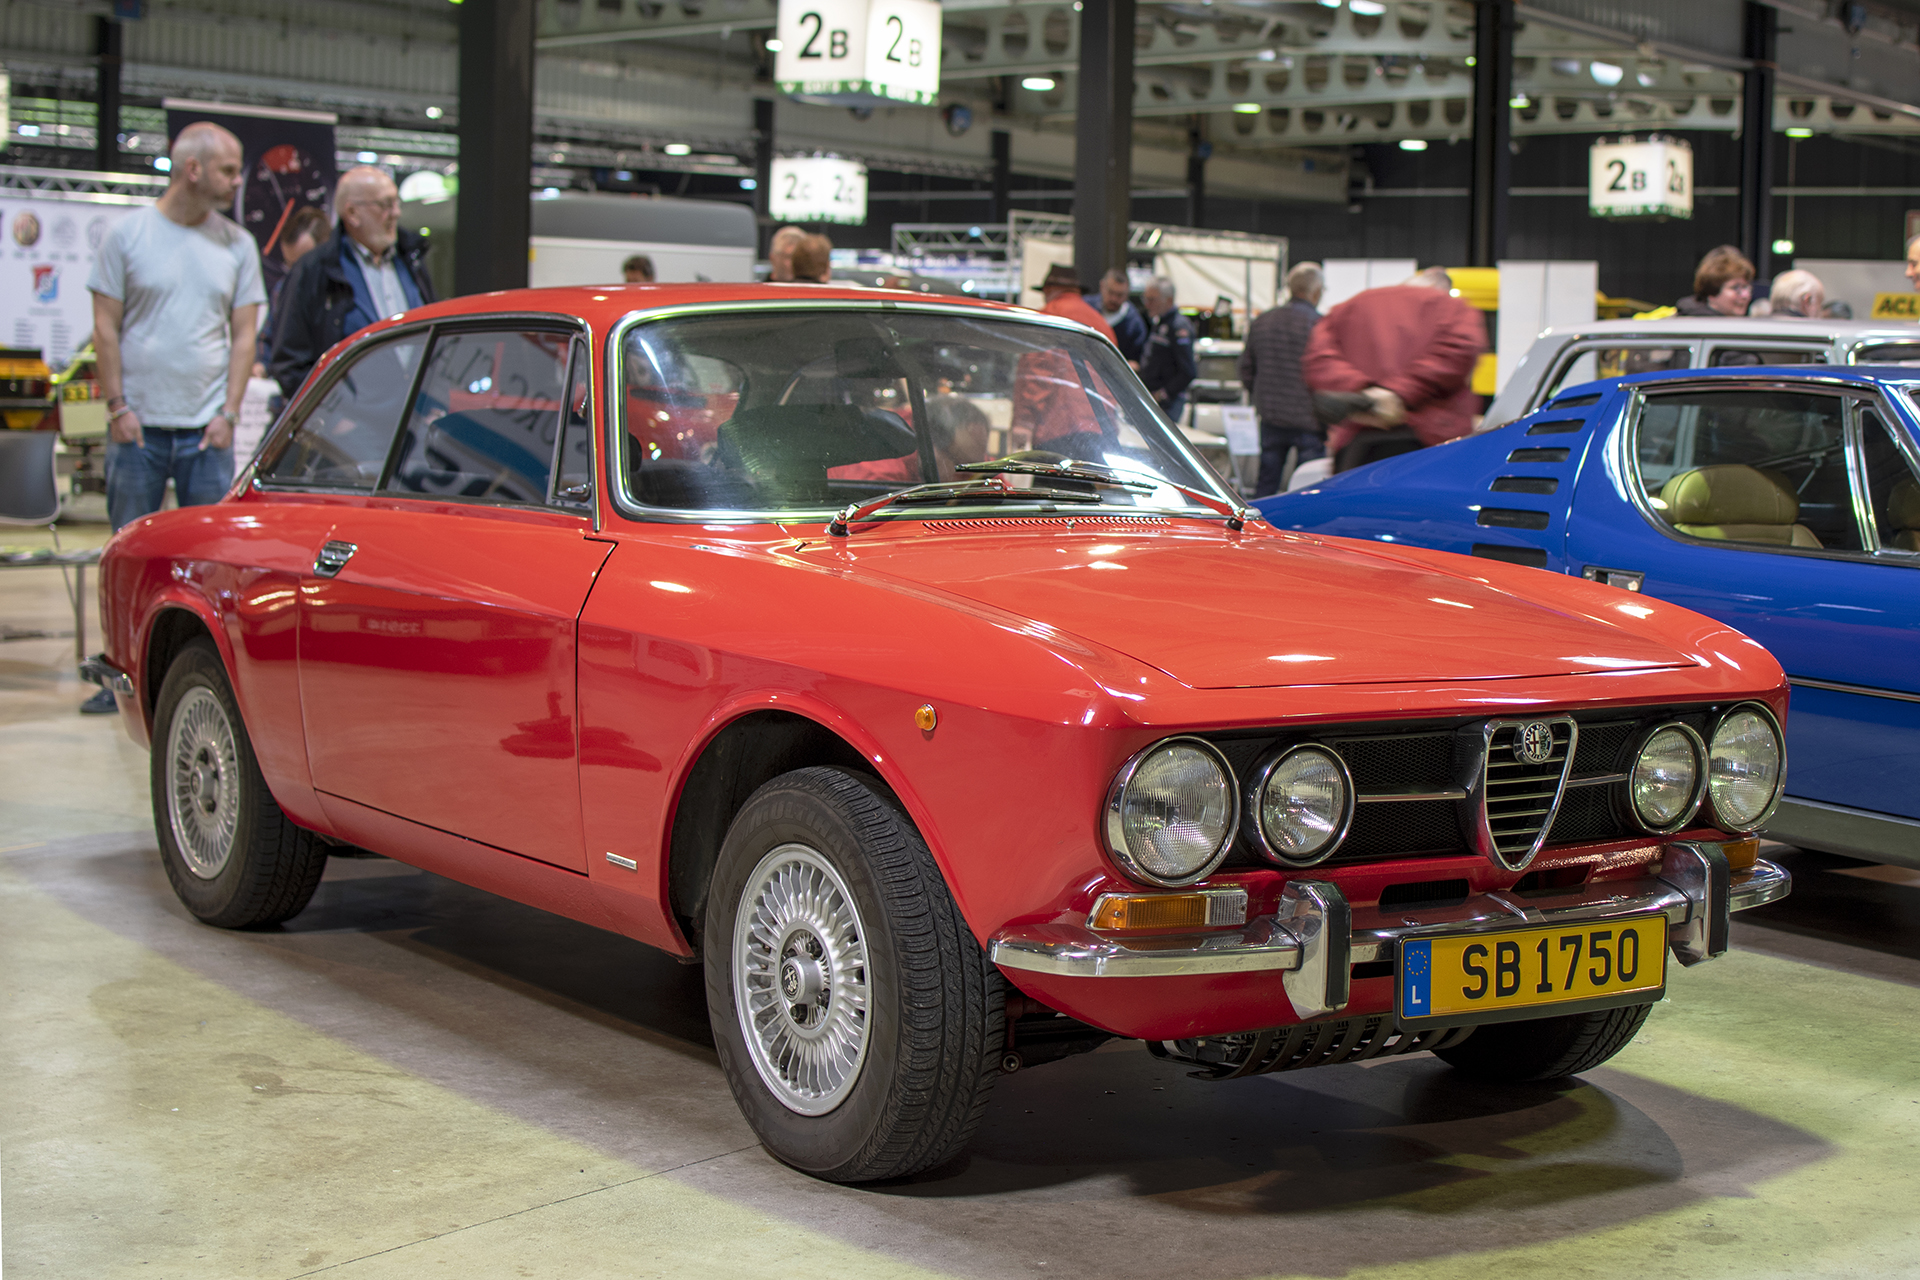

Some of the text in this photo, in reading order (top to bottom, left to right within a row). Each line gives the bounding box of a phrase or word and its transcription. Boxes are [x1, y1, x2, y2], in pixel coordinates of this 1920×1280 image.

[798, 11, 848, 59] 2B
[886, 14, 921, 67] 2B
[1607, 159, 1646, 191] 2B
[1877, 295, 1918, 315] ACL
[1462, 928, 1639, 1000] SB 1750
[1411, 985, 1421, 1004] L
